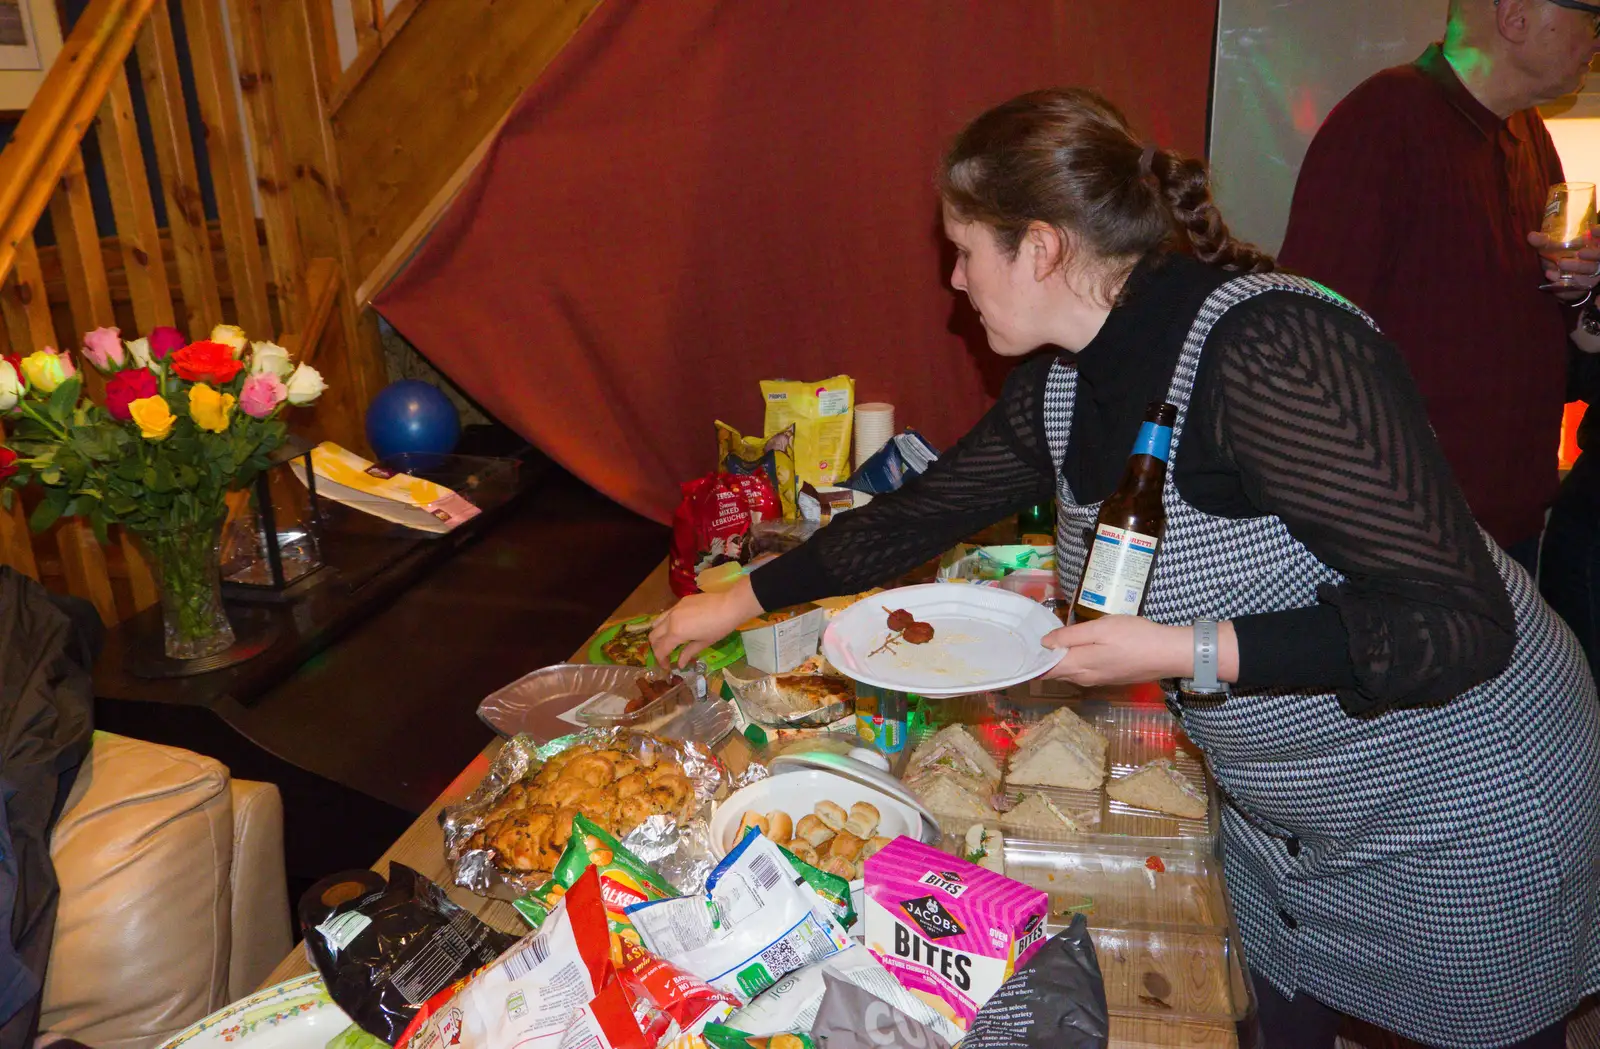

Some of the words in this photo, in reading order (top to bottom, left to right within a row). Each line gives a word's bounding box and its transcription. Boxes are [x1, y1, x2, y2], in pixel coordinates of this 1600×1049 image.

[719, 507, 739, 516] MIXED
[925, 874, 962, 894] BITES
[601, 883, 645, 907] ALKER
[990, 927, 1008, 943] OVEN
[1019, 921, 1043, 954] BITES
[895, 921, 972, 991] BITES
[1000, 990, 1014, 998] field
